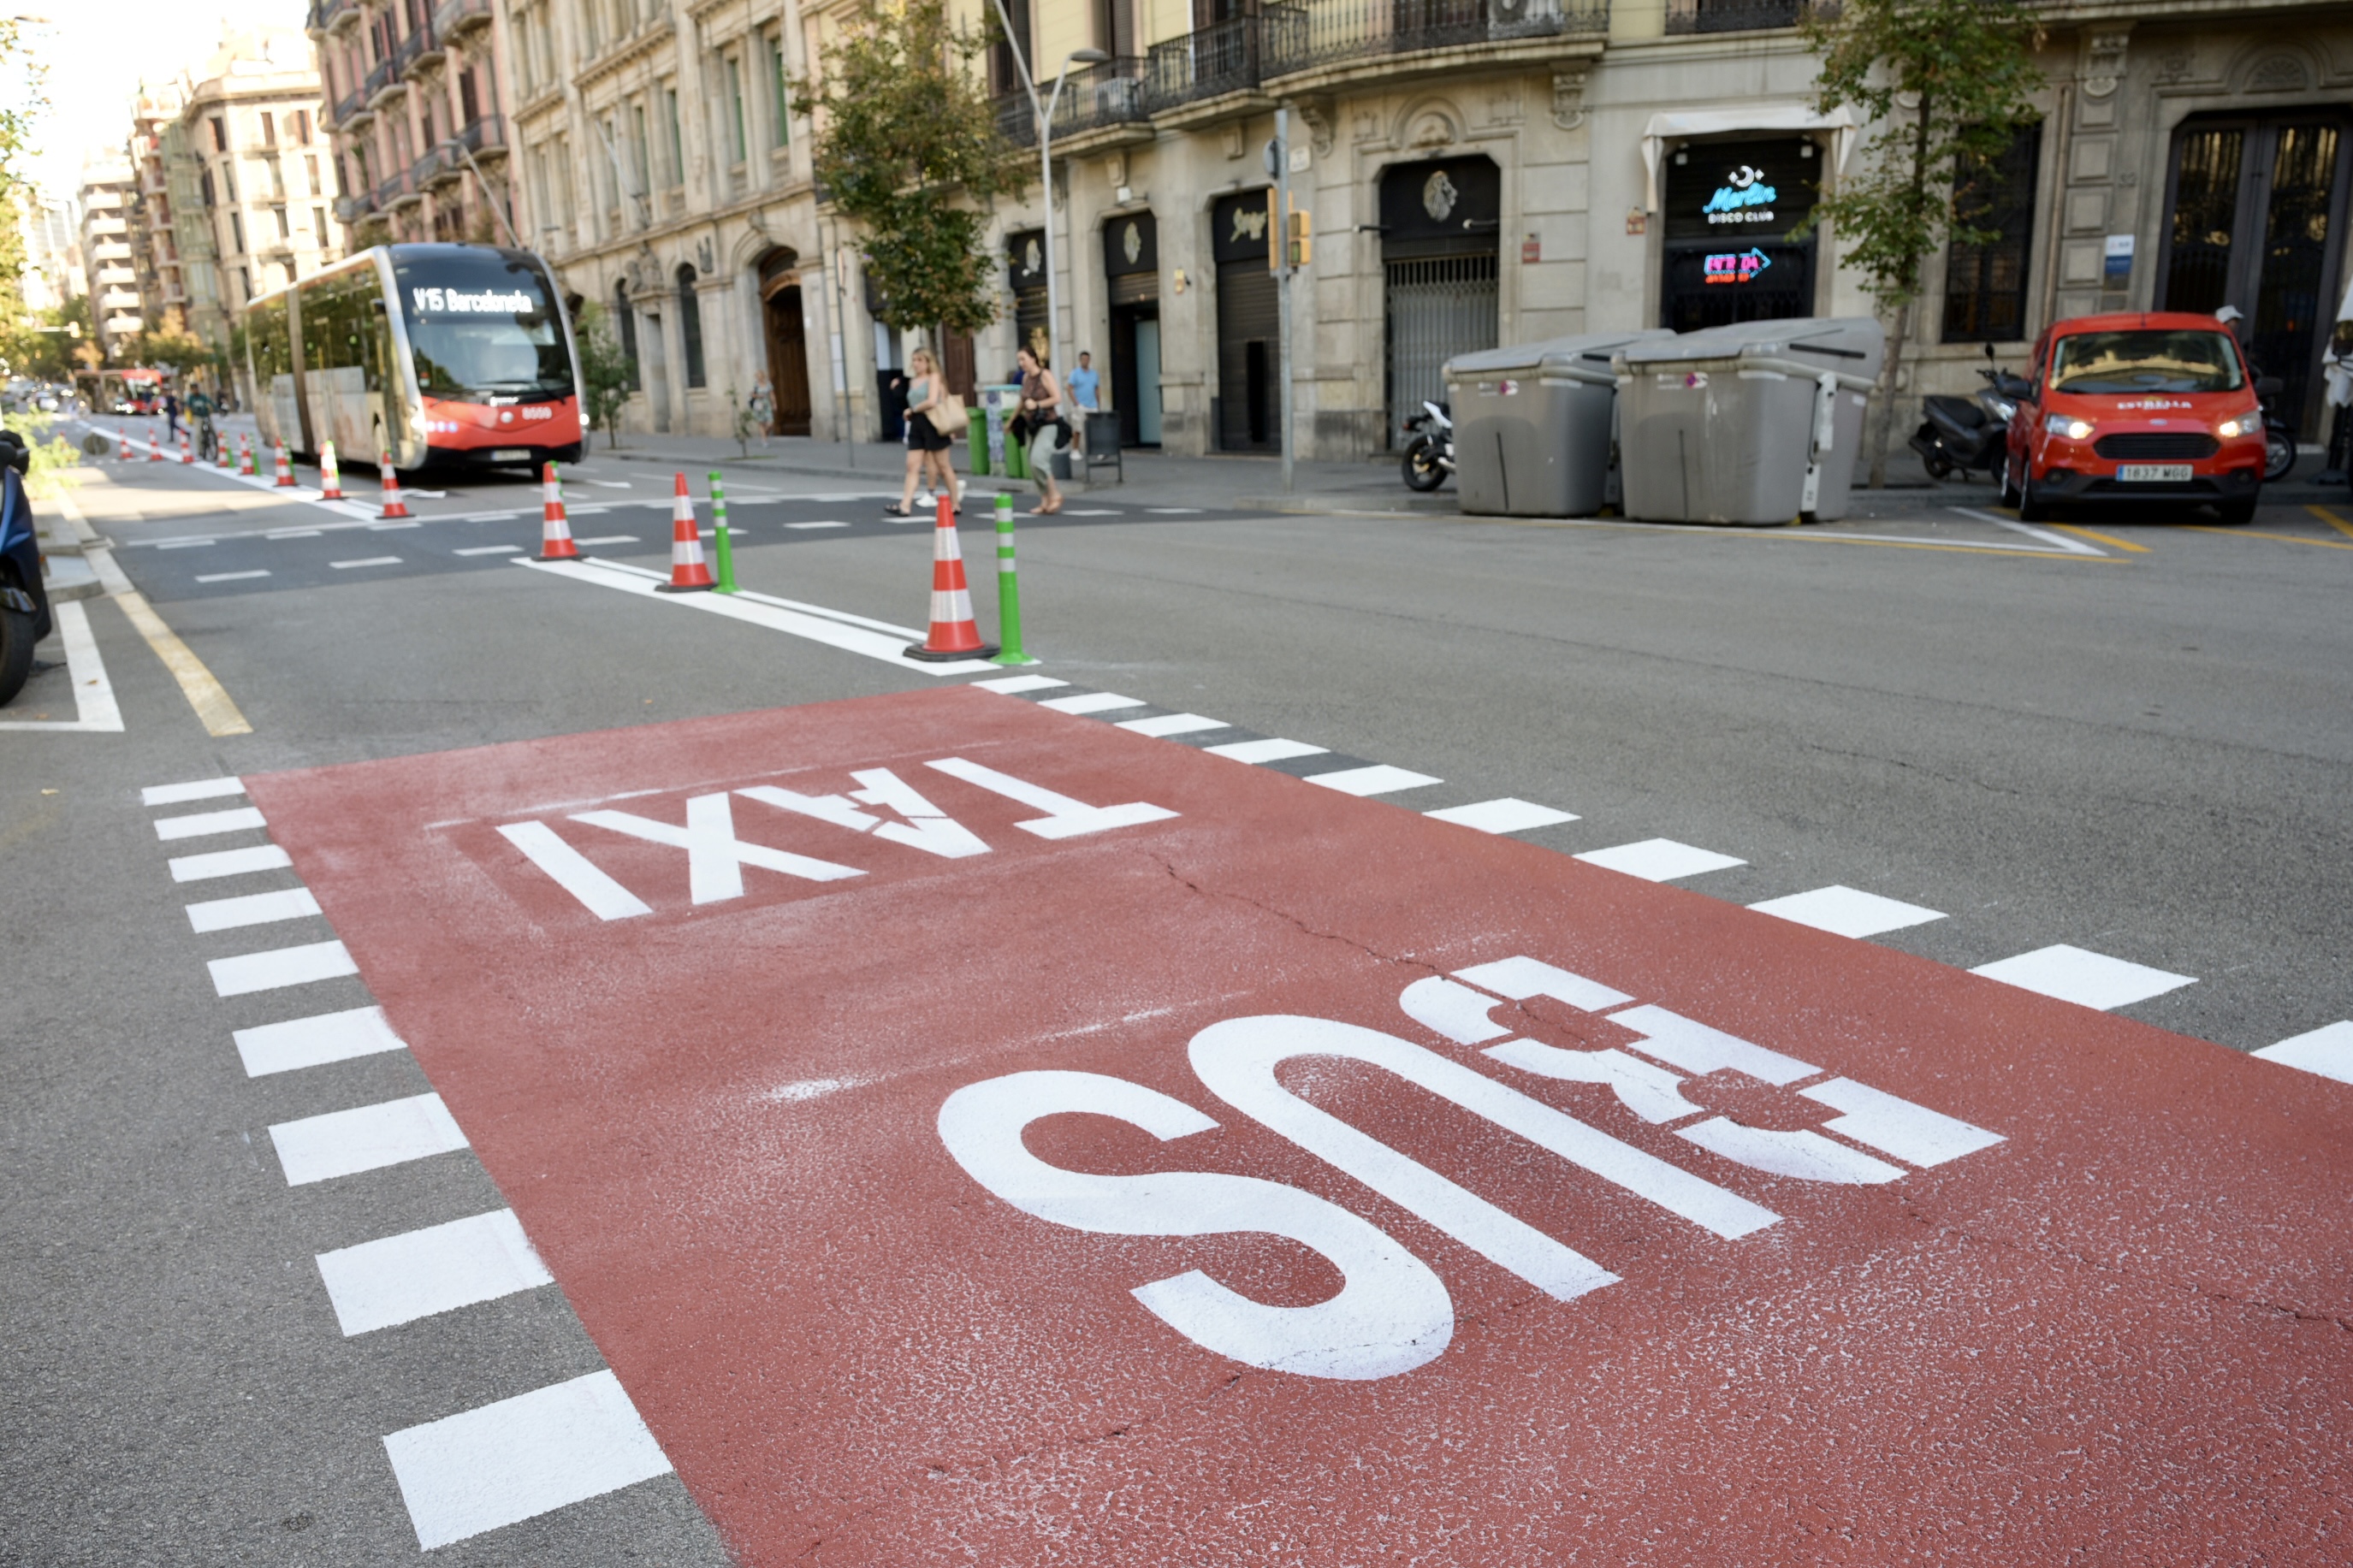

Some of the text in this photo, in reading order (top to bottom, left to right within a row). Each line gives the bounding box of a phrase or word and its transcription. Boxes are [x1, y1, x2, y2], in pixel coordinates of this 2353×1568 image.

[1708, 210, 1775, 223] DISCO CLUB
[412, 287, 533, 312] V15 Barceloneta
[495, 757, 1181, 921] TAXI
[936, 956, 2008, 1381] BUS
